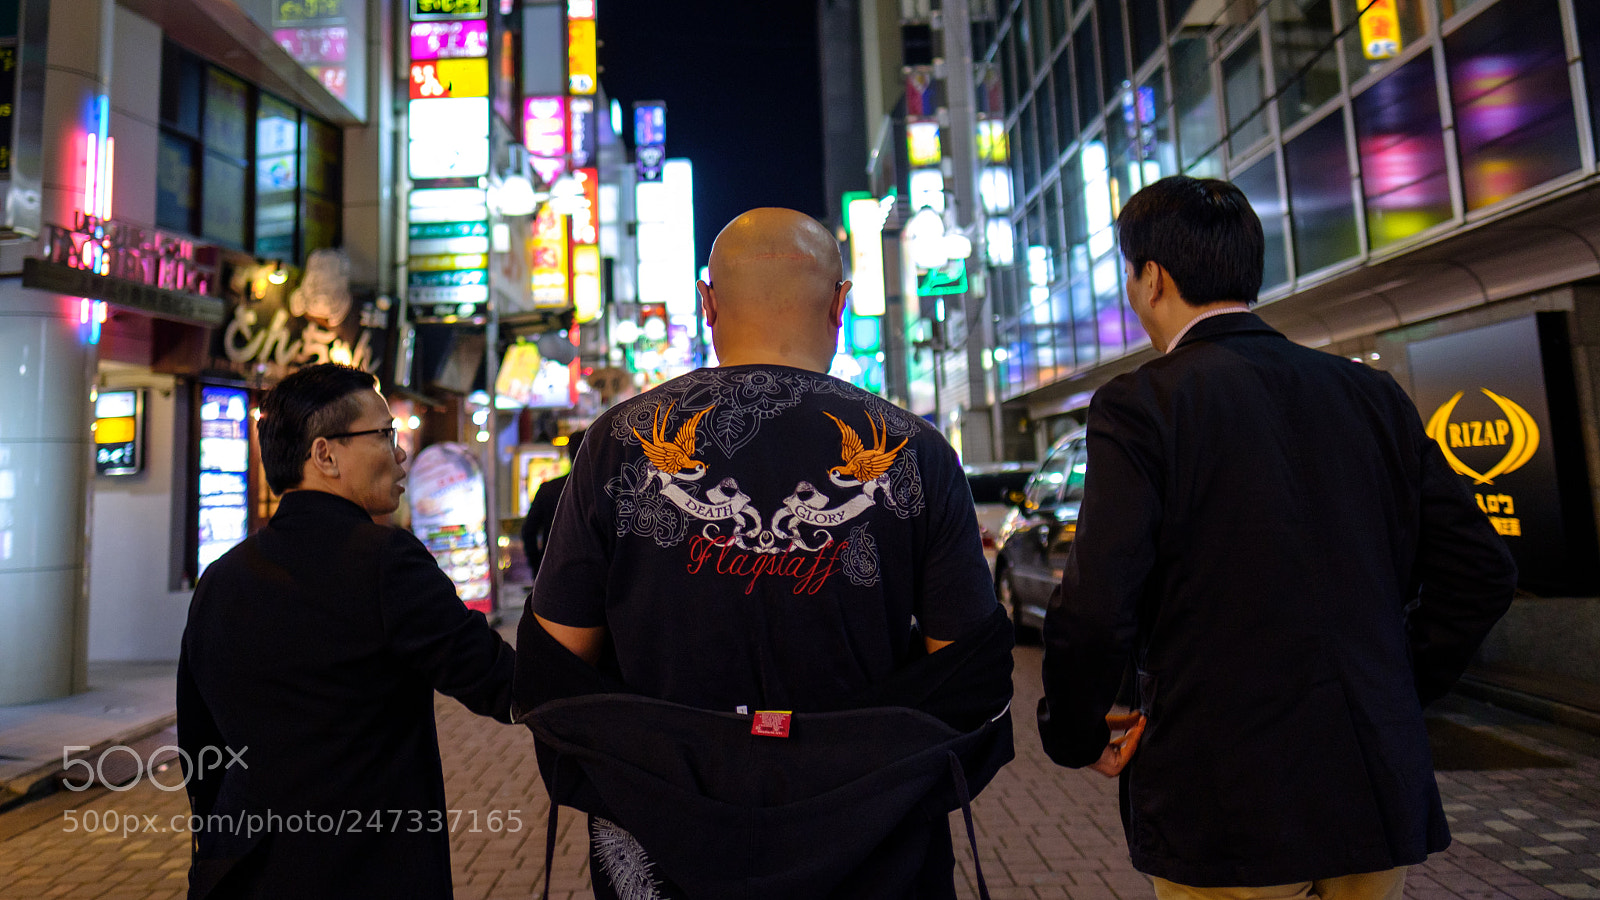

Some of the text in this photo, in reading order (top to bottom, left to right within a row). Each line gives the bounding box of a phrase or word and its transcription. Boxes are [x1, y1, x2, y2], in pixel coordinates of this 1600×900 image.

[1448, 419, 1510, 448] RIZAP
[685, 498, 734, 518] DEATH
[795, 505, 846, 524] GLORY
[686, 534, 849, 595] Flagstaff
